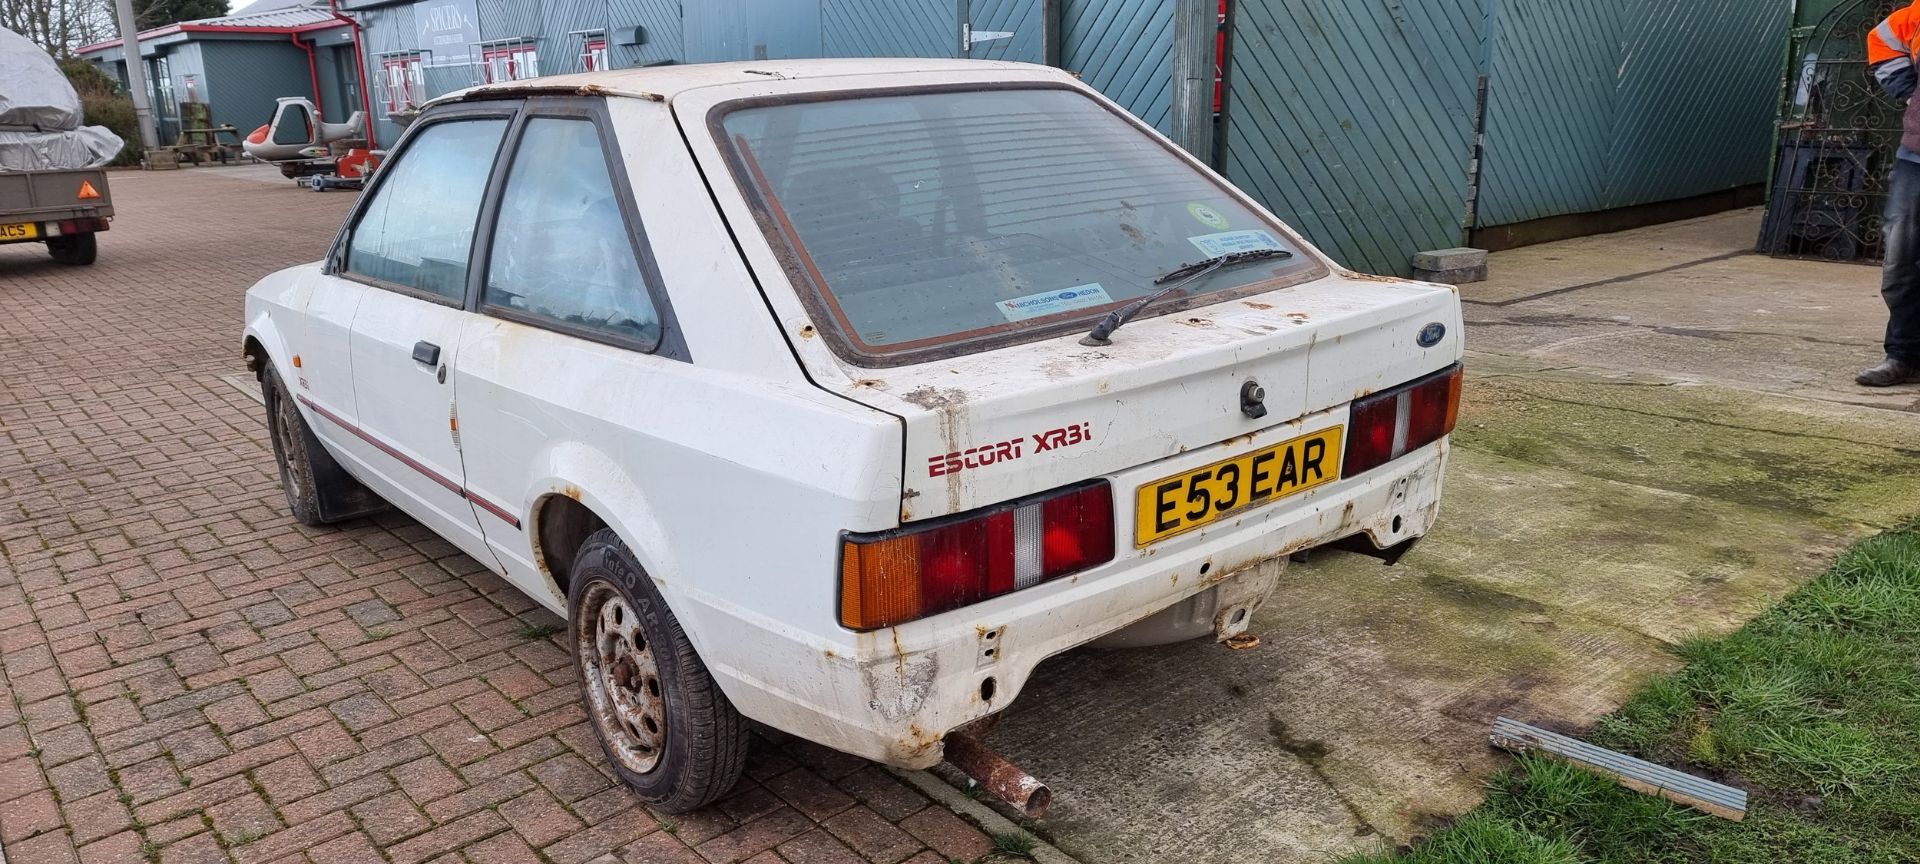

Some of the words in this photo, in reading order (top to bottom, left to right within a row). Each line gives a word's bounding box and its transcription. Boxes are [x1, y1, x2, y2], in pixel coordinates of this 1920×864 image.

[430, 4, 462, 32] SPICERS
[0, 224, 26, 237] ACS
[928, 437, 1024, 478] ESCORT
[1032, 422, 1092, 454] XR3i
[1155, 463, 1240, 533] E53
[1250, 437, 1326, 501] EAR
